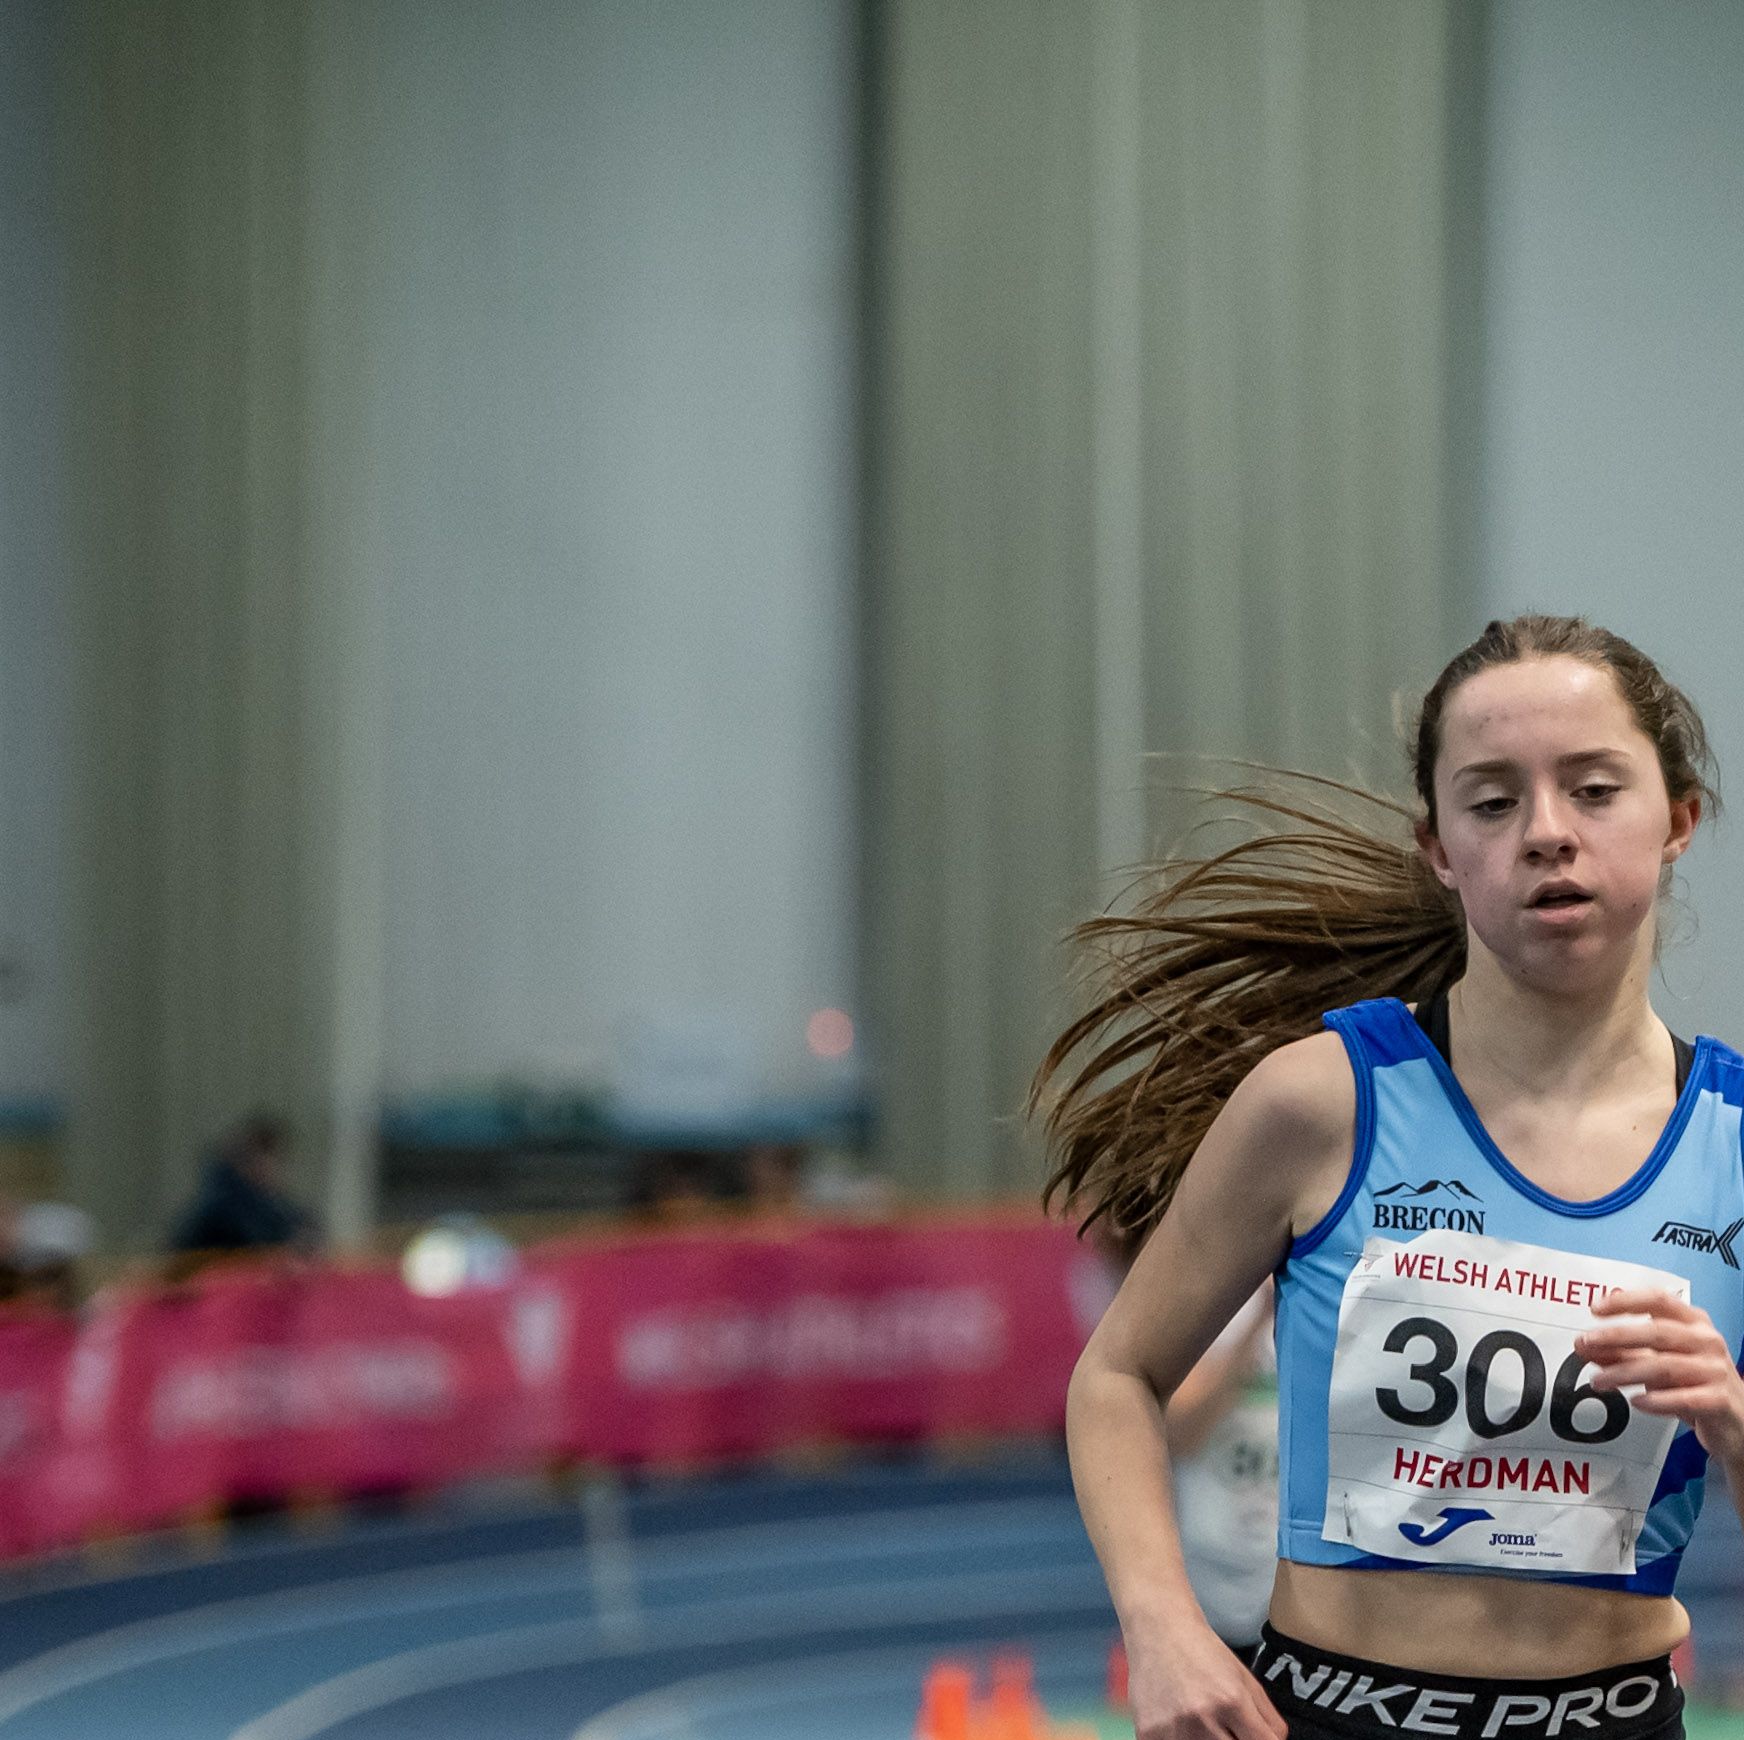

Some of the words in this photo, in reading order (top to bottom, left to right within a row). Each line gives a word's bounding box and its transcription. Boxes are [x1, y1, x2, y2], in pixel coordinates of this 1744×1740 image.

[1372, 1203, 1486, 1235] BRECON
[1394, 1252, 1489, 1289] WELSH
[1495, 1267, 1625, 1308] ATHLETI
[1375, 1316, 1631, 1444] 306
[1393, 1447, 1590, 1495] HERDMAN
[1264, 1652, 1475, 1736] NIKE
[1480, 1675, 1659, 1739] PRO
